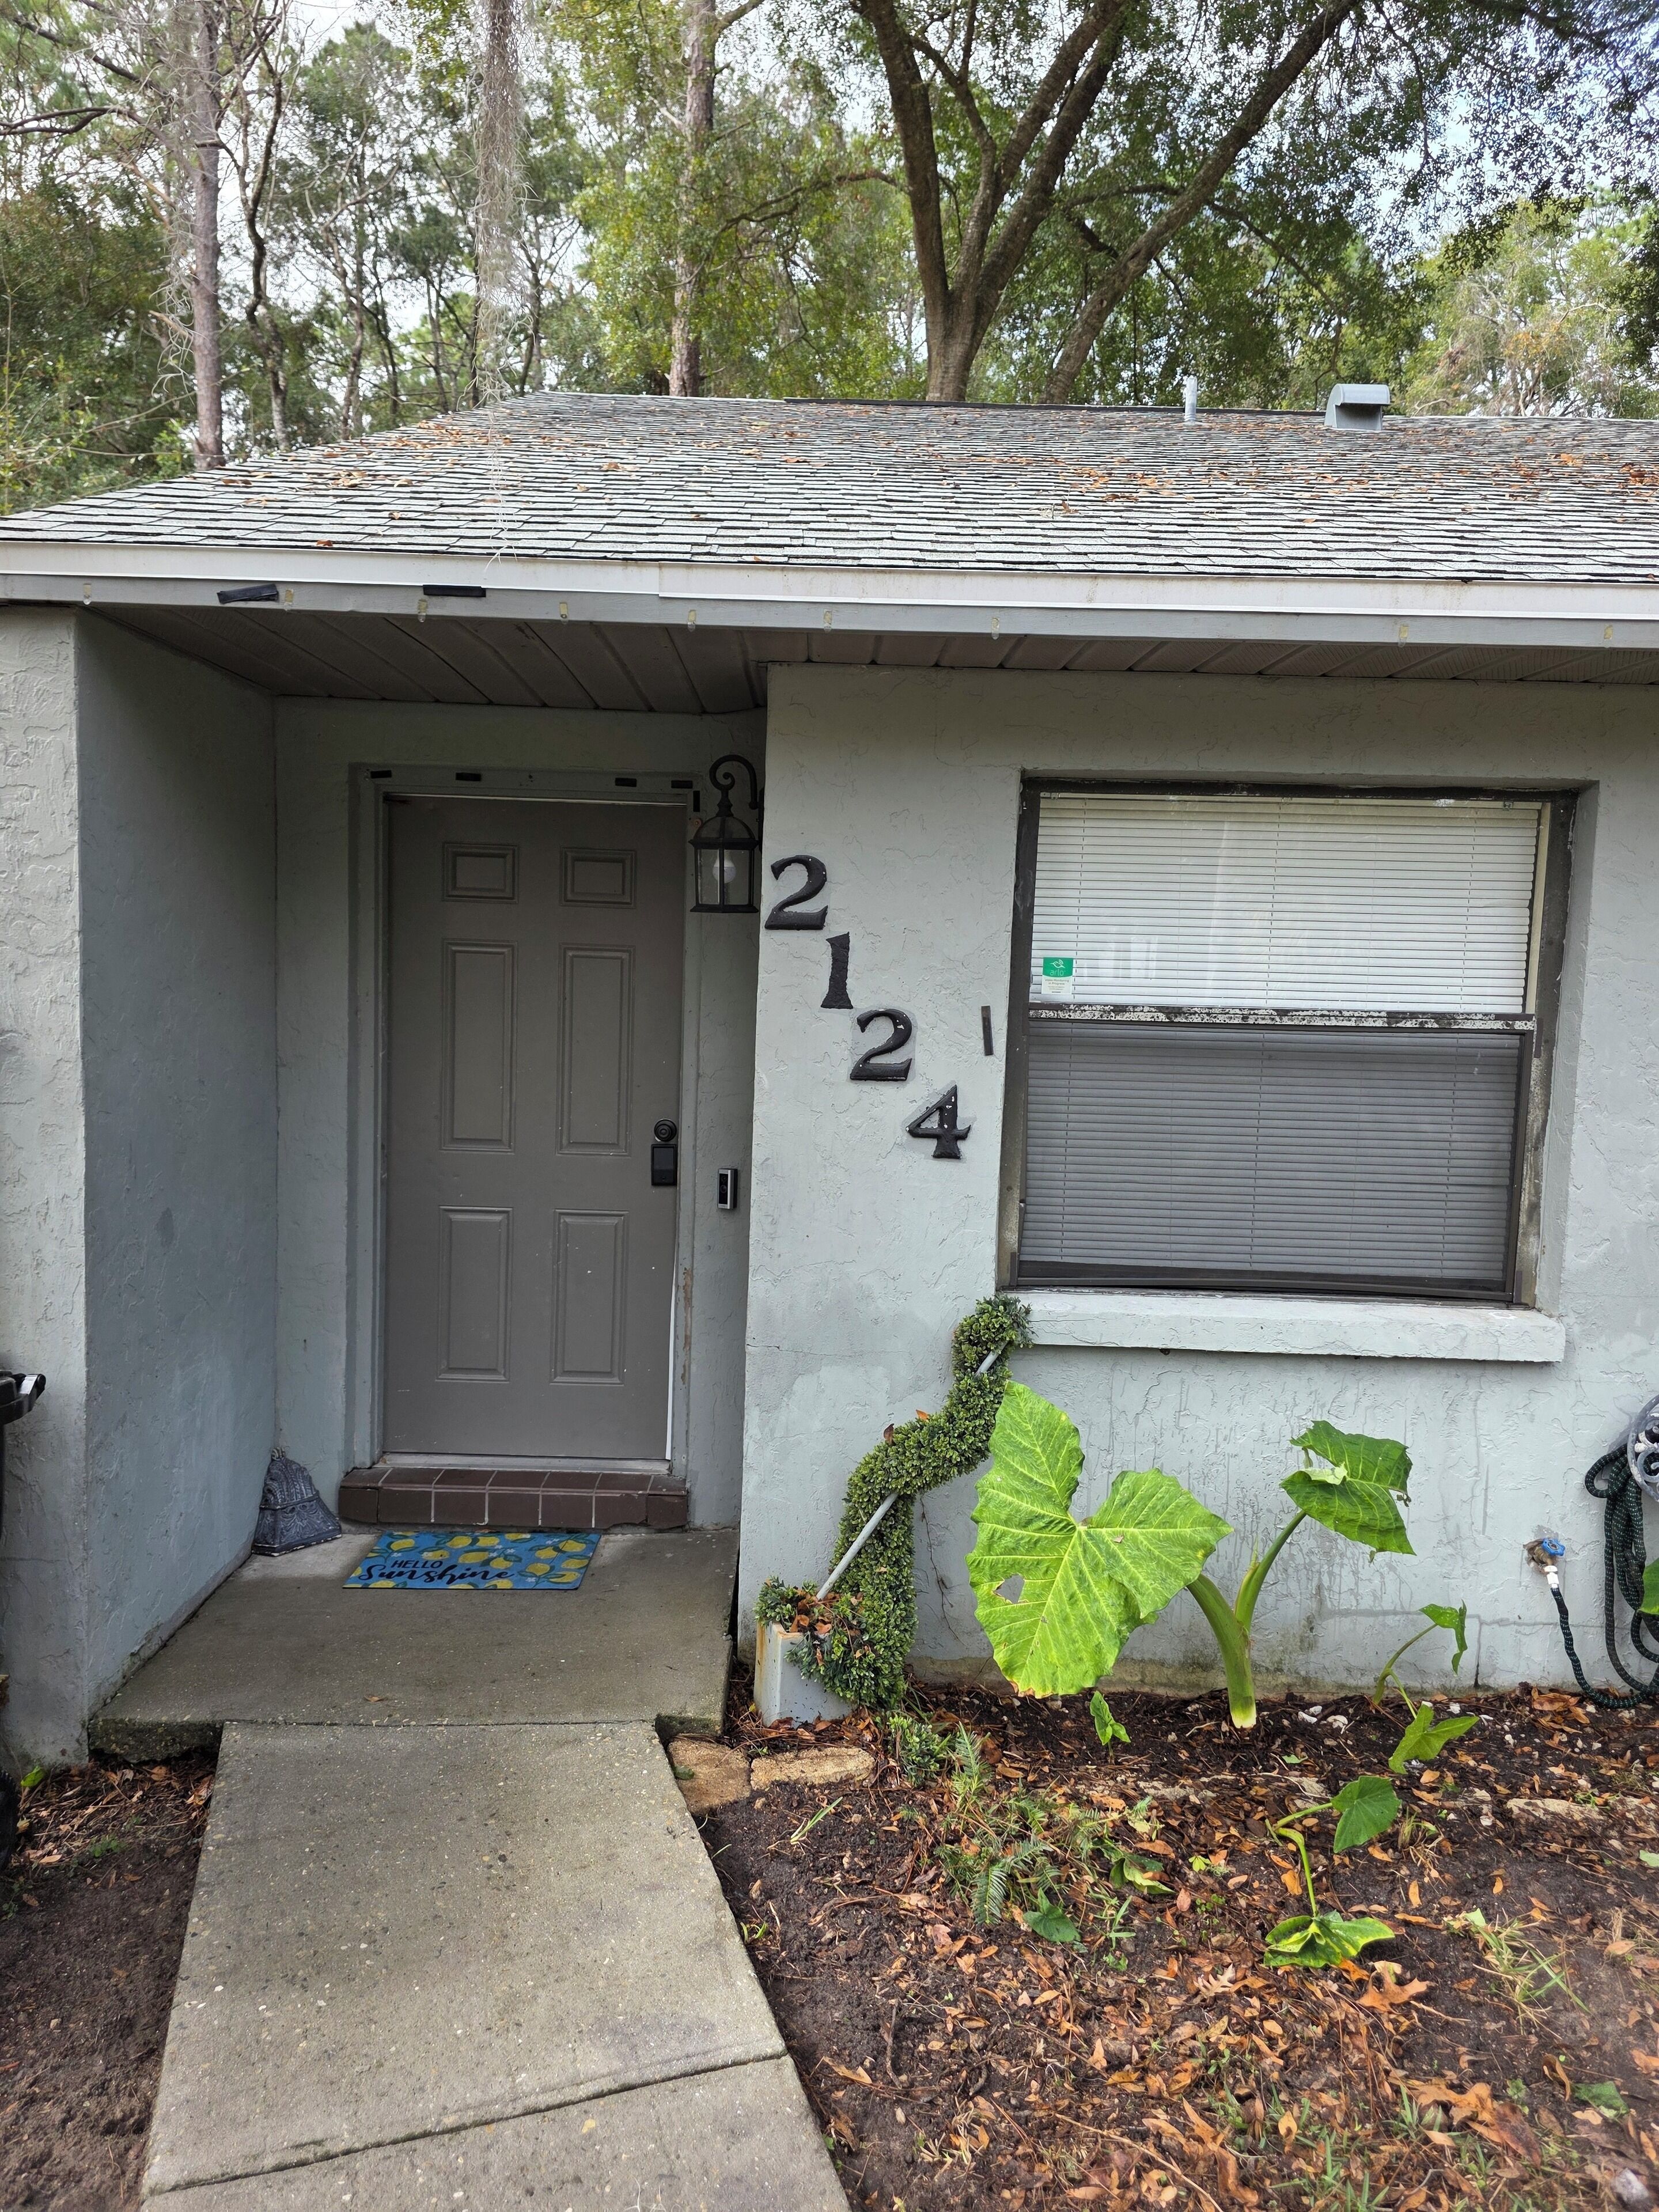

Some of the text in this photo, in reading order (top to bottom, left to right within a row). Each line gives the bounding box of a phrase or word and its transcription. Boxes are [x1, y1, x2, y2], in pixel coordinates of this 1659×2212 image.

[1050, 968, 1064, 976] arlo
[391, 1560, 443, 1569] HELLO
[358, 1564, 515, 1585] Sunshine
